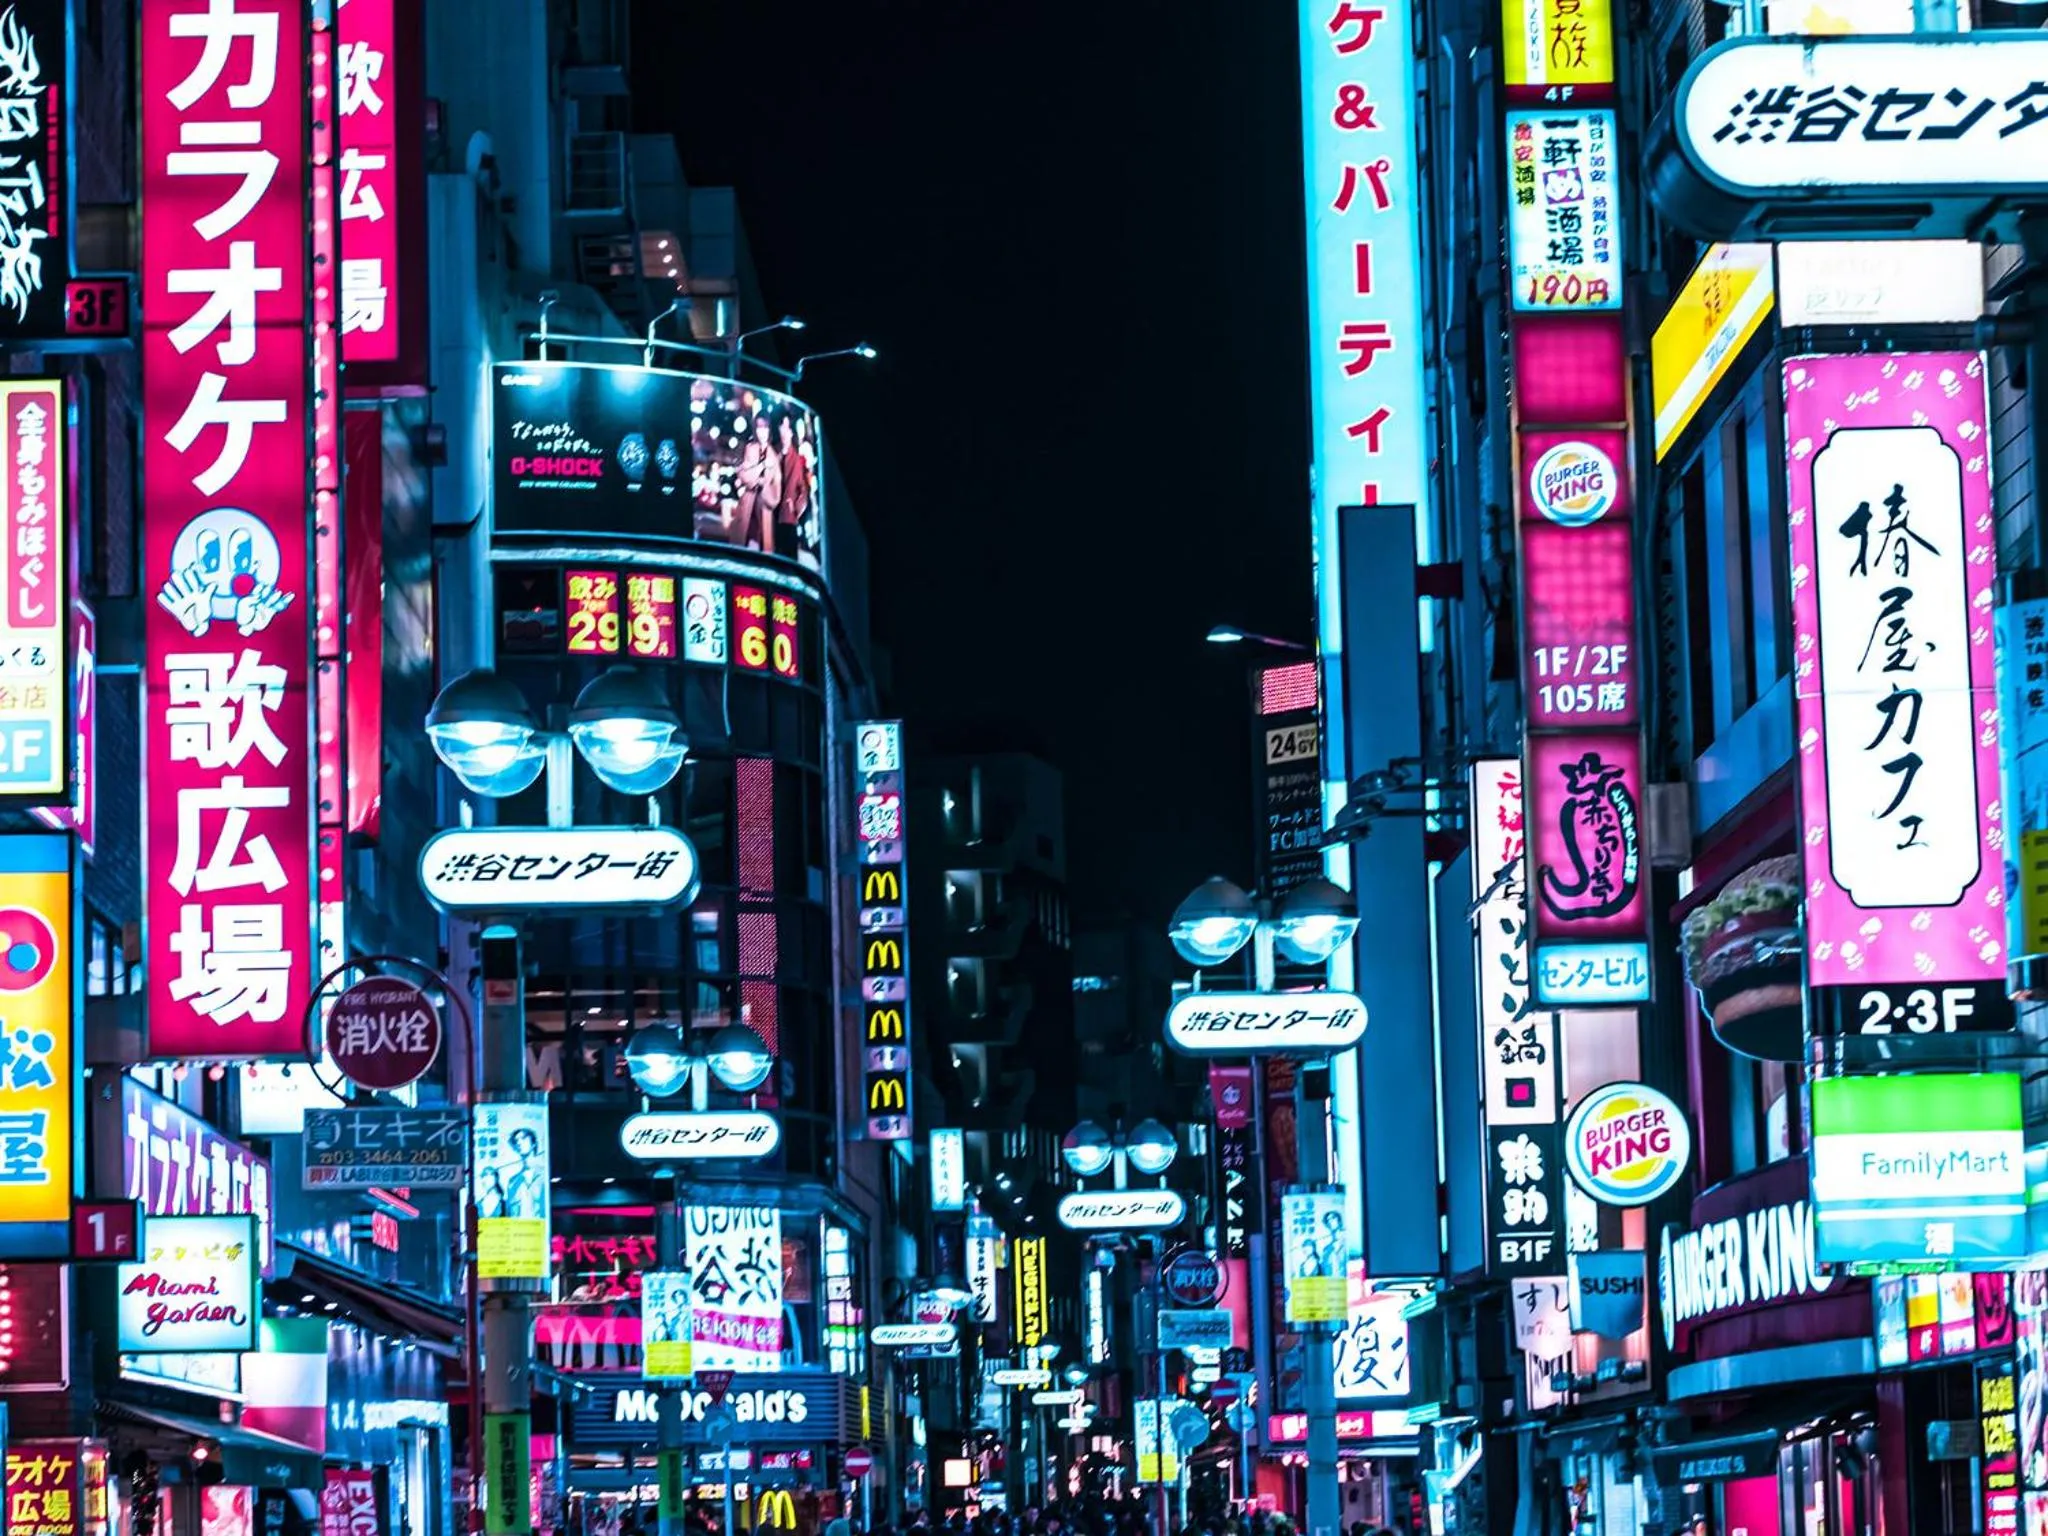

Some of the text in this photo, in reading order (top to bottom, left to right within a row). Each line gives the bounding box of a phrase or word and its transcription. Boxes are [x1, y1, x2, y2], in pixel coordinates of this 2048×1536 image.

[1544, 86, 1574, 101] 4F
[1541, 118, 1585, 266] 一軒め酒場
[1528, 274, 1610, 305] 190円
[74, 288, 116, 327] 3F
[1545, 461, 1600, 488] BURGER
[1548, 474, 1603, 506] KING
[16, 401, 47, 619] 全身もみほぐし
[1839, 484, 1941, 850] 椿屋カフェ
[1539, 683, 1627, 714] 105席
[1271, 731, 1296, 758] 24
[436, 850, 680, 883] 渋谷センター街
[1540, 958, 1646, 988] センタービル
[336, 1010, 430, 1057] 消火栓
[1181, 1008, 1358, 1032] 渋谷センター街
[629, 1126, 770, 1145] 渋谷センター街
[1585, 1109, 1666, 1149] BURGER
[1590, 1129, 1672, 1177] KING
[1862, 1151, 2009, 1179] FamilyMart
[1500, 1239, 1551, 1262] B1F
[122, 1273, 220, 1298] Miami
[1581, 1277, 1645, 1294] SUSHI
[1673, 1218, 1745, 1323] BURGER
[1518, 1283, 1570, 1314] すし
[615, 1390, 807, 1423] Mcoald's
